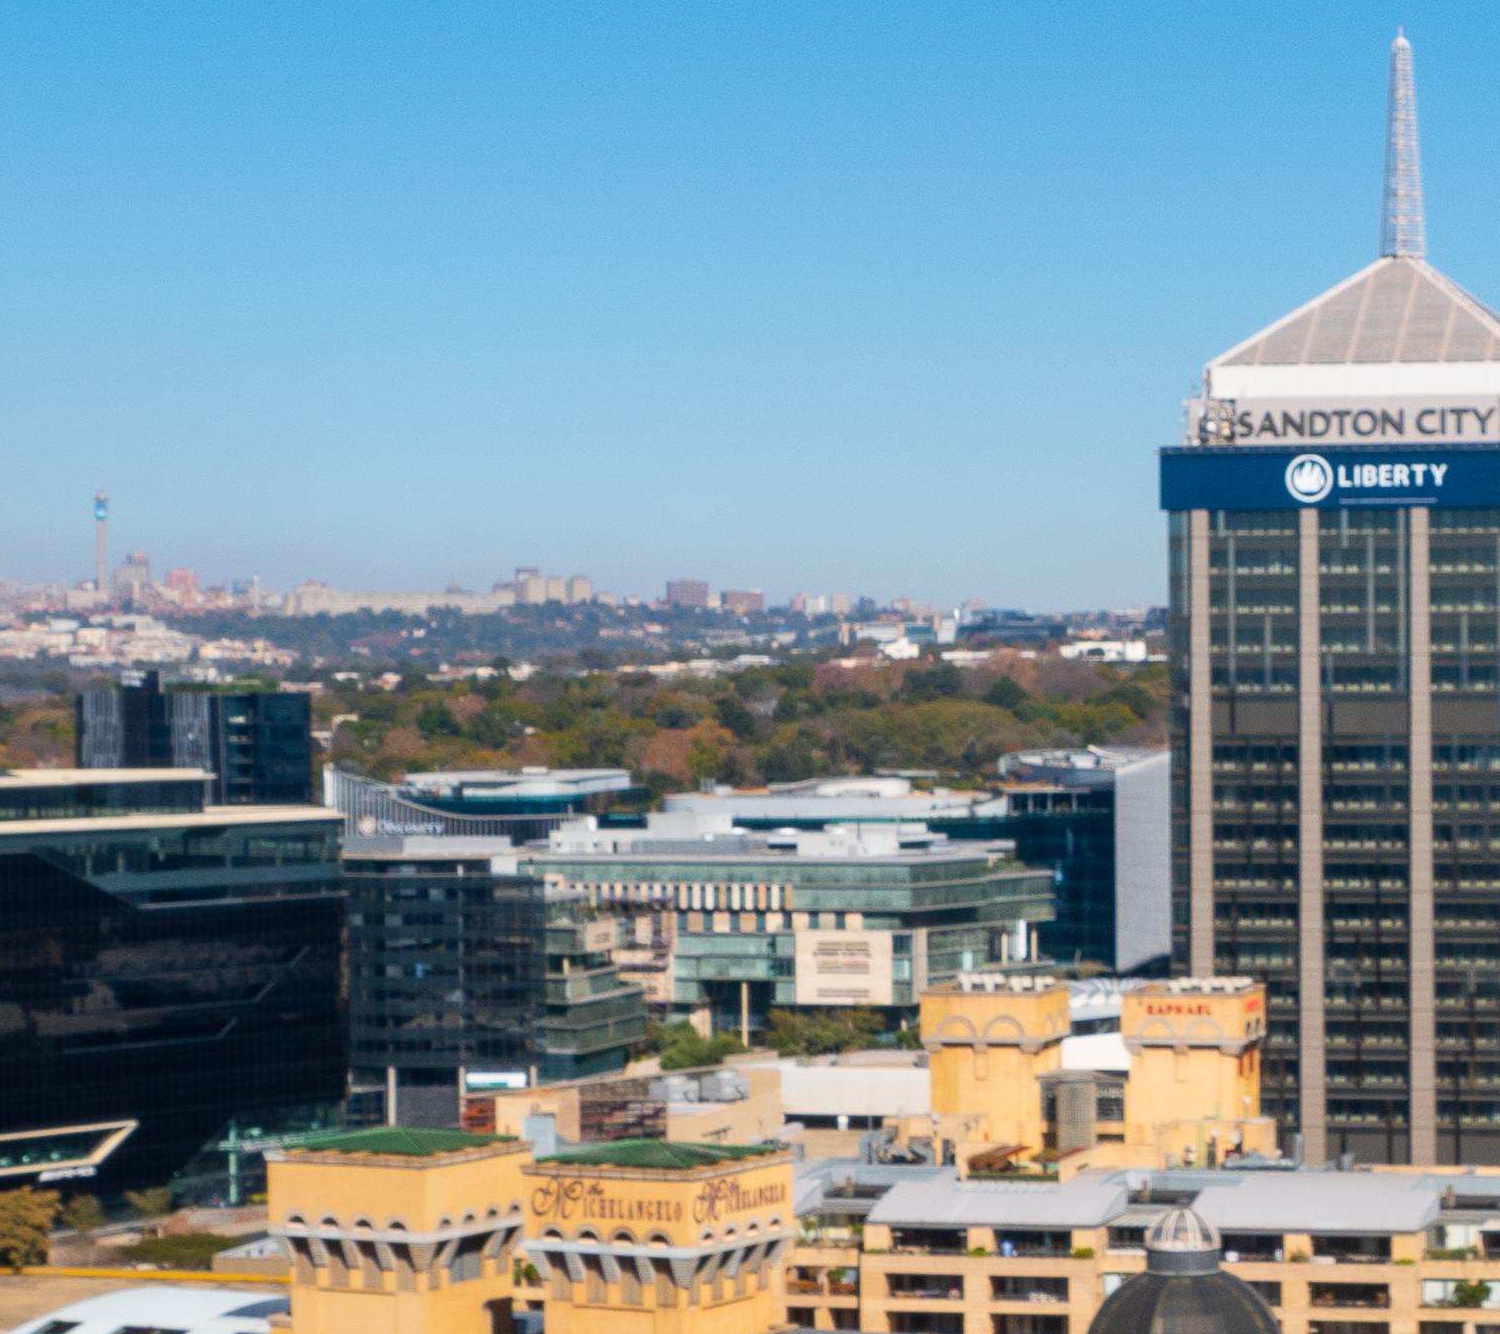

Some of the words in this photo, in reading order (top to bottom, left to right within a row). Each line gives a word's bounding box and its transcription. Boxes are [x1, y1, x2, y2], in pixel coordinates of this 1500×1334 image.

[1237, 409, 1404, 437] SANDTON
[1416, 408, 1495, 435] CITY
[1337, 463, 1448, 488] LIBERTY
